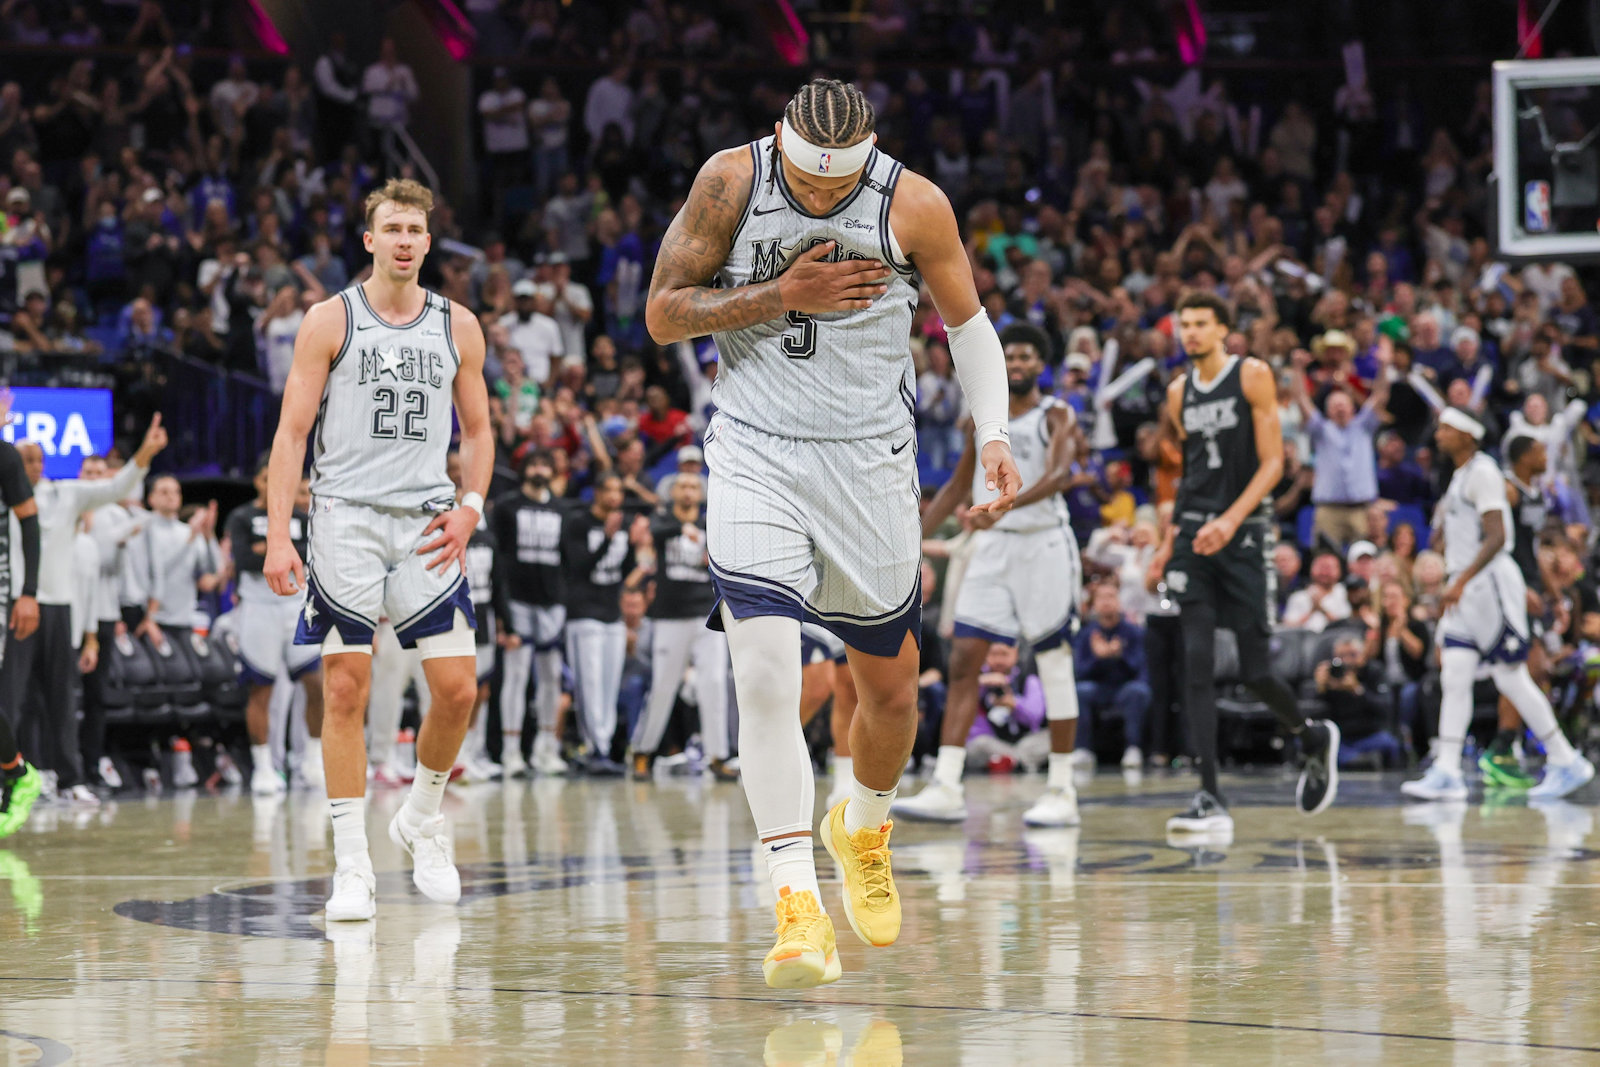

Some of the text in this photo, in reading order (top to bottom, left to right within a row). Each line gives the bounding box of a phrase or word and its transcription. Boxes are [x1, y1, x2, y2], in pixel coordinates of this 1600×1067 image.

[869, 180, 883, 192] PW
[781, 310, 818, 360] 5
[370, 386, 428, 442] 22
[1204, 439, 1222, 470] 1
